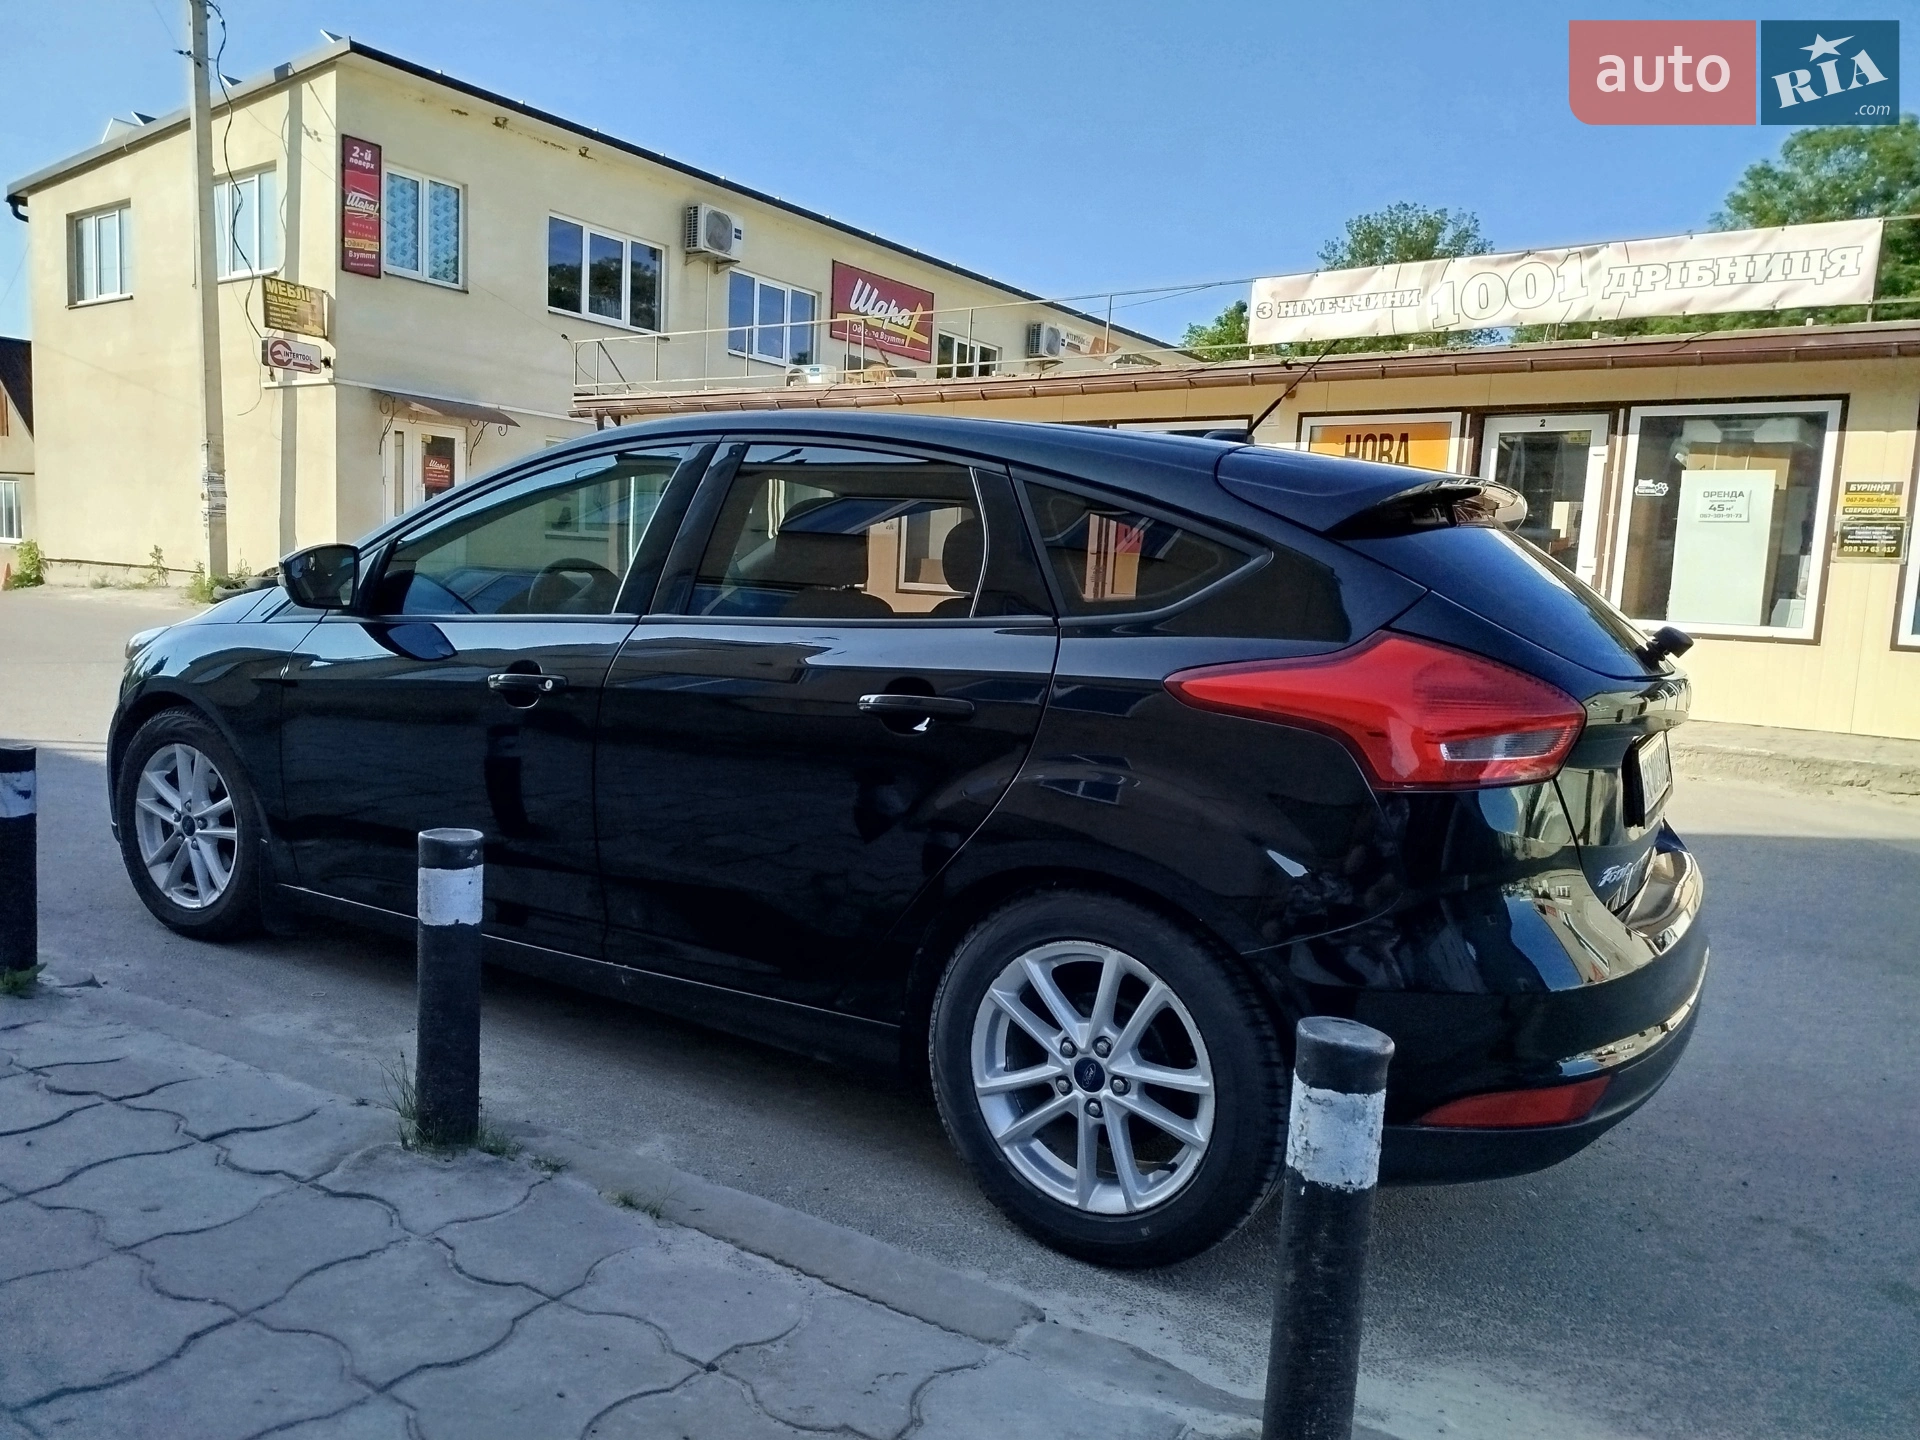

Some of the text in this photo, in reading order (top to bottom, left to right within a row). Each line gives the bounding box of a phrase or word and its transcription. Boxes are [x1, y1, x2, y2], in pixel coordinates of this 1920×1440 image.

[352, 146, 372, 161] 2-й
[349, 157, 375, 169] поверх
[348, 250, 376, 259] Взуття
[265, 279, 311, 302] МЕБЛІ
[1256, 245, 1864, 329] З НІМЕЧЧИНИ 1001 ДРІБНИЦЯ
[880, 331, 905, 345] Взуття
[284, 351, 312, 361] INTERTOOL
[1540, 419, 1546, 427] 2
[1345, 433, 1410, 465] НОВА
[1849, 483, 1891, 491] БУРІННЯ
[1703, 490, 1745, 498] ОРЕНДА
